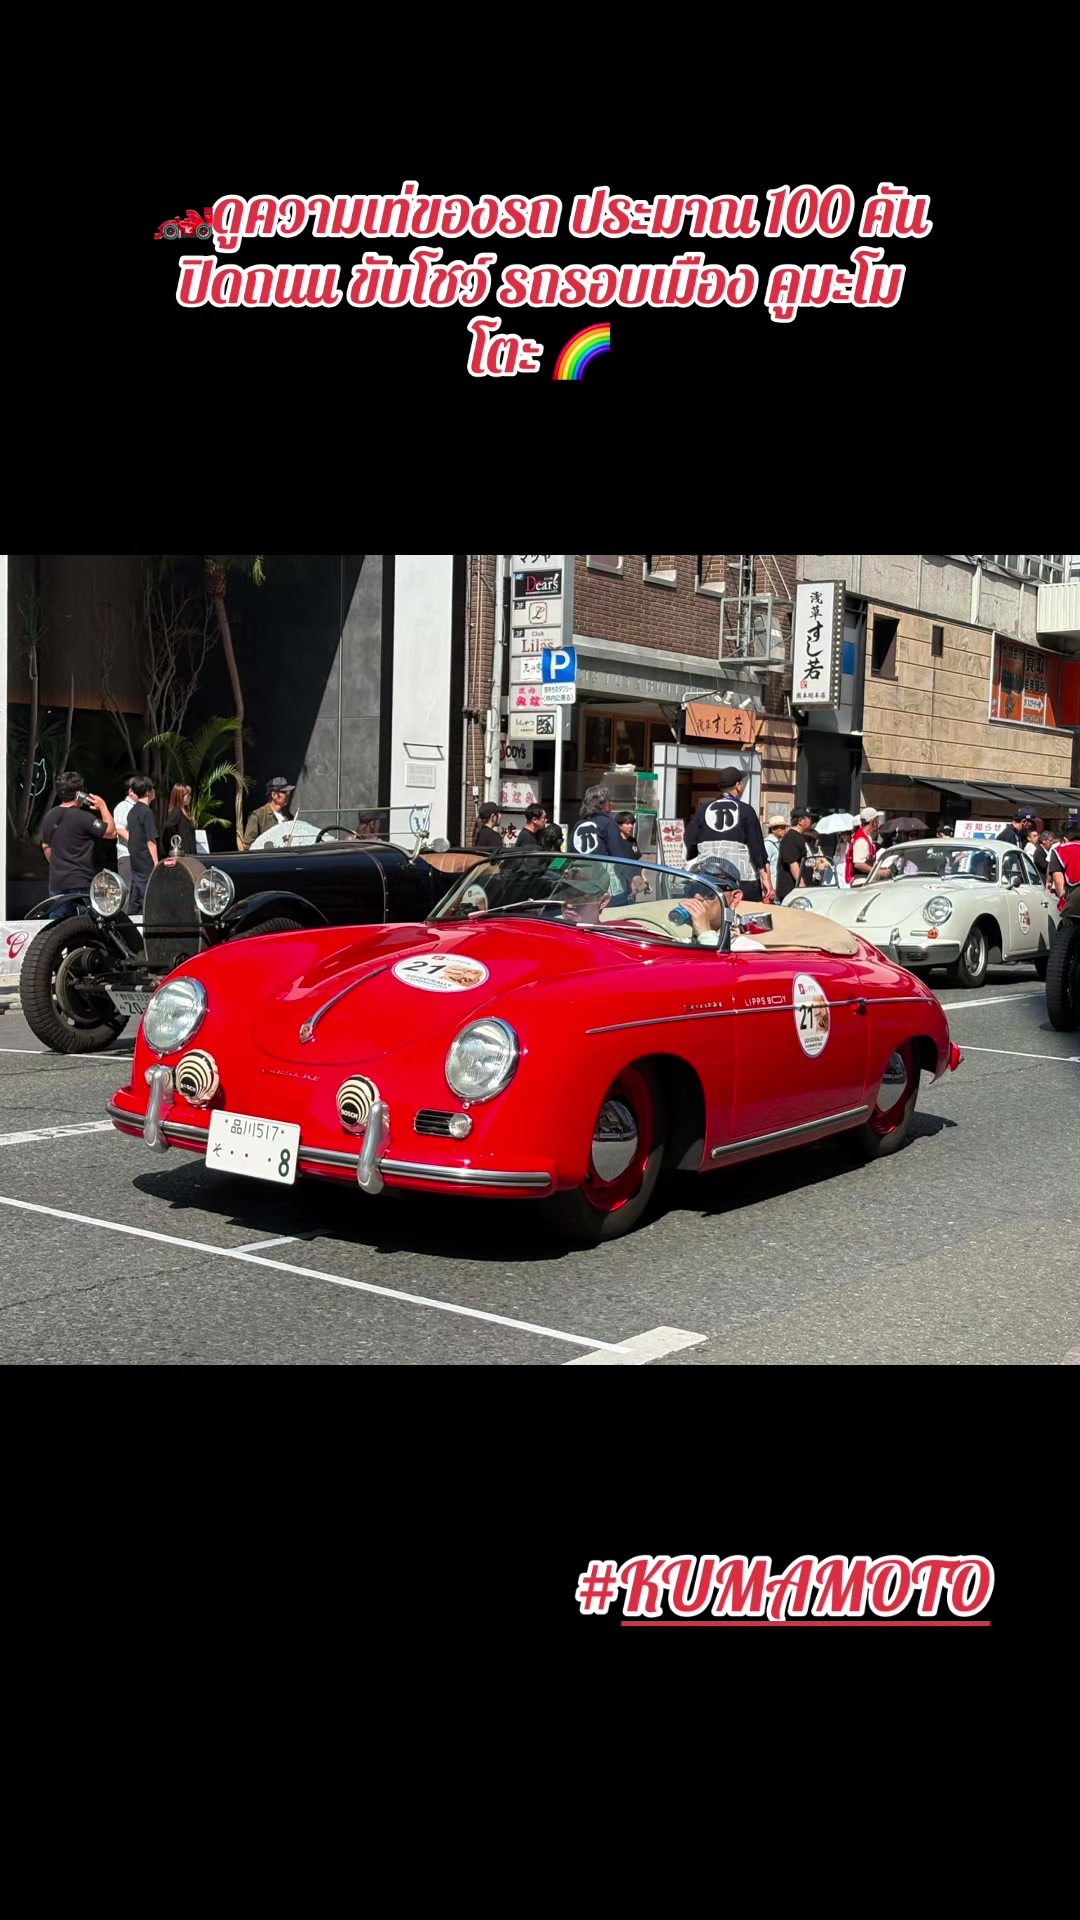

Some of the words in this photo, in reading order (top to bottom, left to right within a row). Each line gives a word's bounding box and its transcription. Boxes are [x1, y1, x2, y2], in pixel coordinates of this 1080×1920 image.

[804, 591, 824, 680] 浅草すし若
[550, 650, 570, 680] P
[965, 822, 1002, 831] お知らせ
[402, 960, 447, 974] 21
[745, 997, 766, 1007] LIPPS
[799, 1003, 814, 1030] 21
[340, 1108, 359, 1120] BOSCH
[256, 1123, 280, 1141] 517
